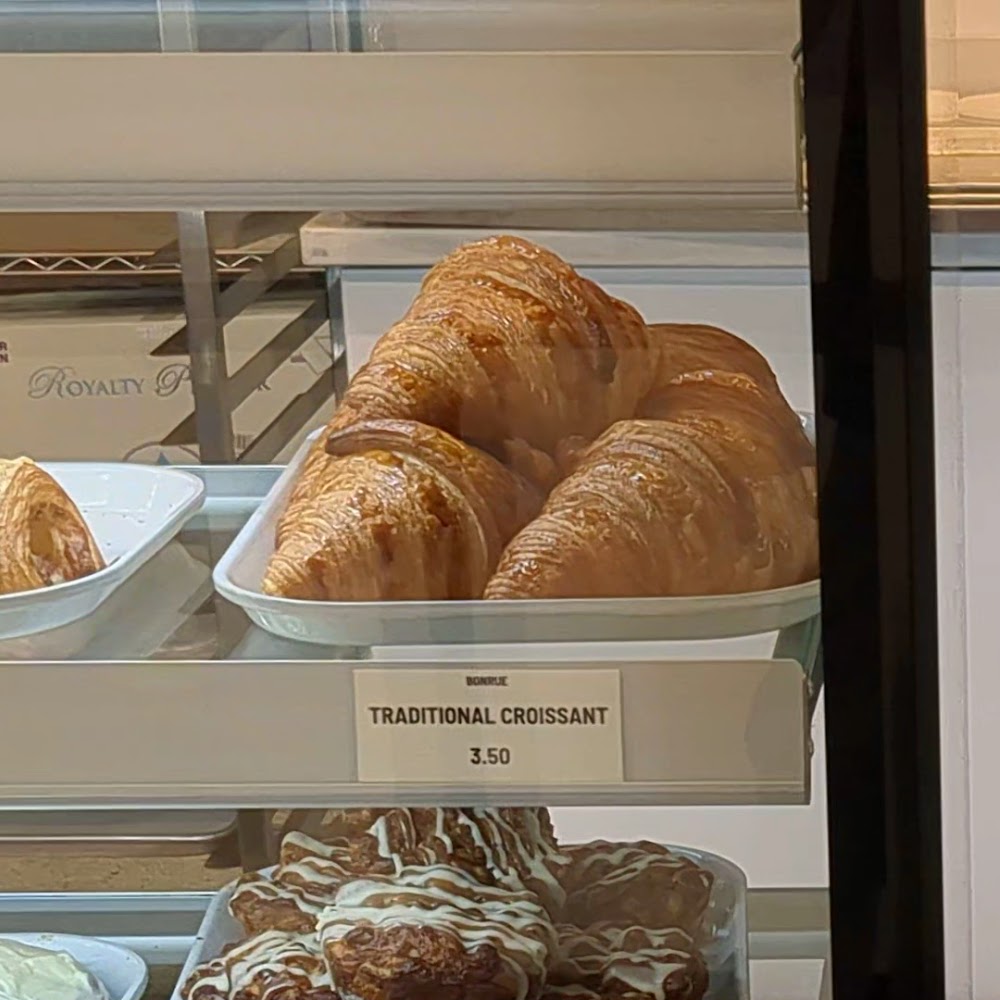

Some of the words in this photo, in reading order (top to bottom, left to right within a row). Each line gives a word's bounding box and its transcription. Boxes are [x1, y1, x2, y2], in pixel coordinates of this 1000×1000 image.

[466, 676, 508, 686] BONRUE
[368, 706, 496, 725] TRADITIONAL
[500, 706, 609, 725] CROISSANT
[469, 747, 511, 765] 3.50
